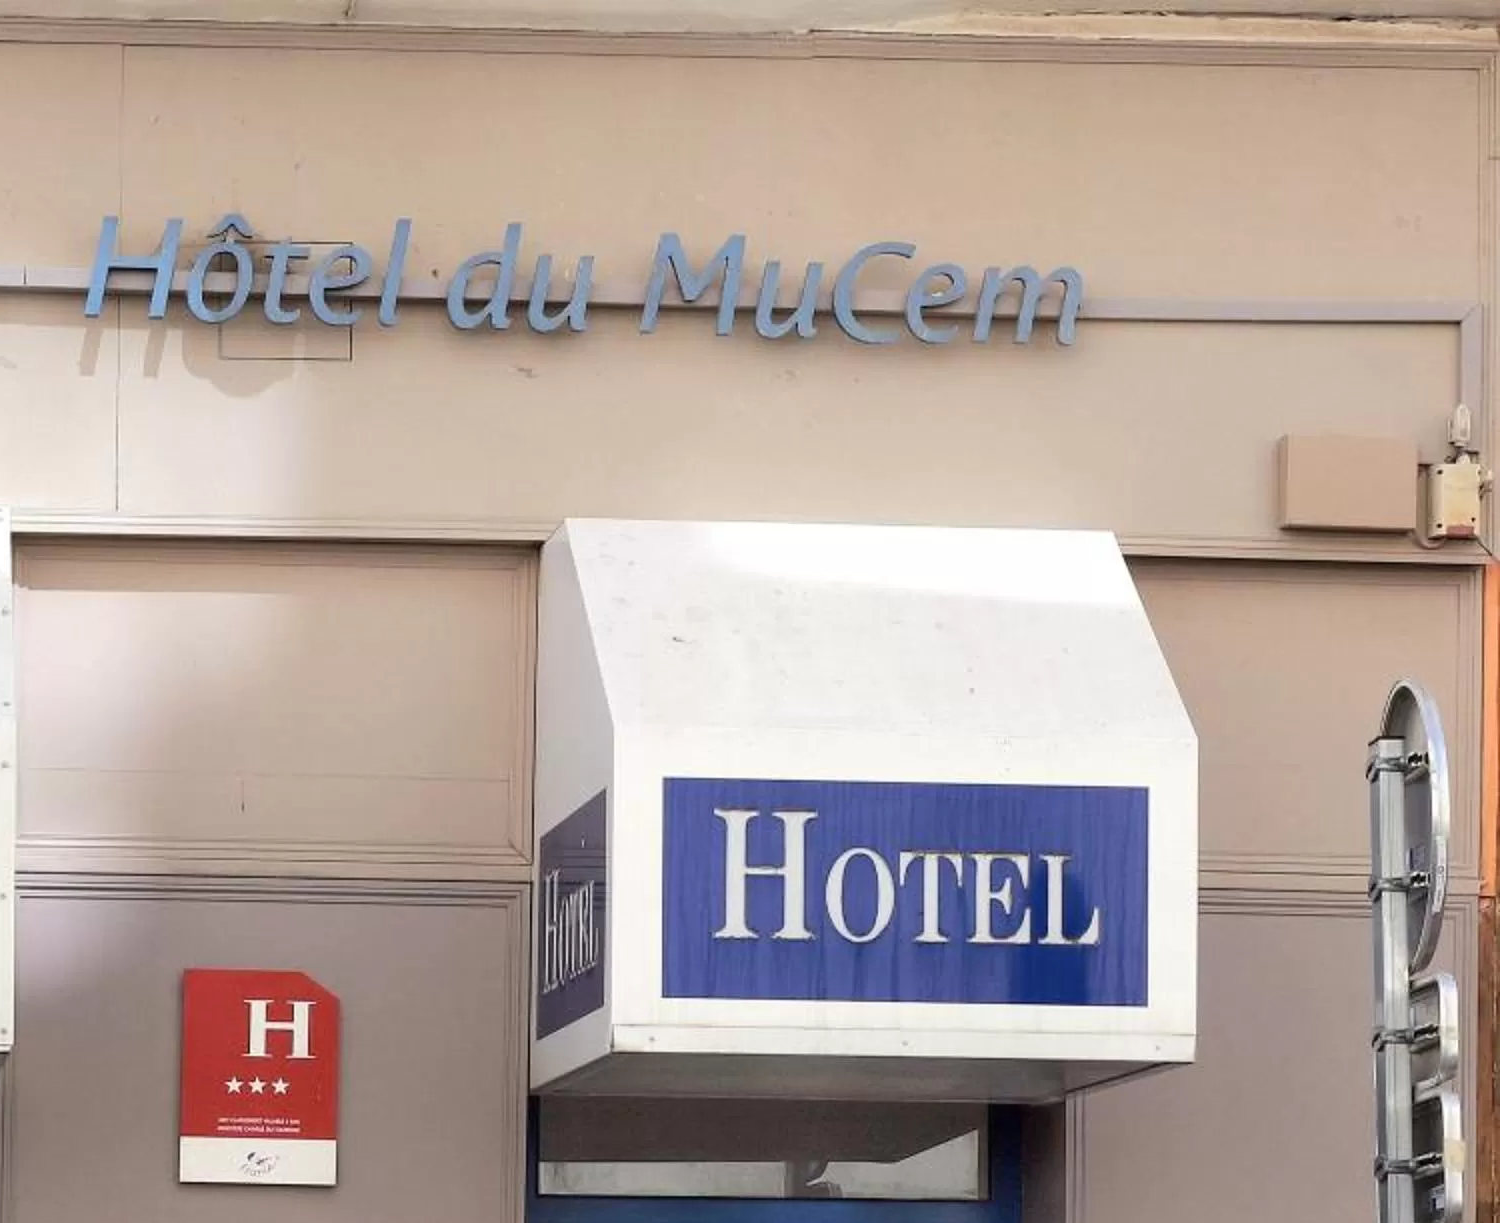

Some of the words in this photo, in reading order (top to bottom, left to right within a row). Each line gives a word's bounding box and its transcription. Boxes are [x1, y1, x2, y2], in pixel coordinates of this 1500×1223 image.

[84, 213, 413, 328] Hôtel
[445, 221, 595, 333] du
[638, 232, 1085, 346] MuCem
[712, 807, 1100, 946] HOTEL
[241, 998, 317, 1060] H
